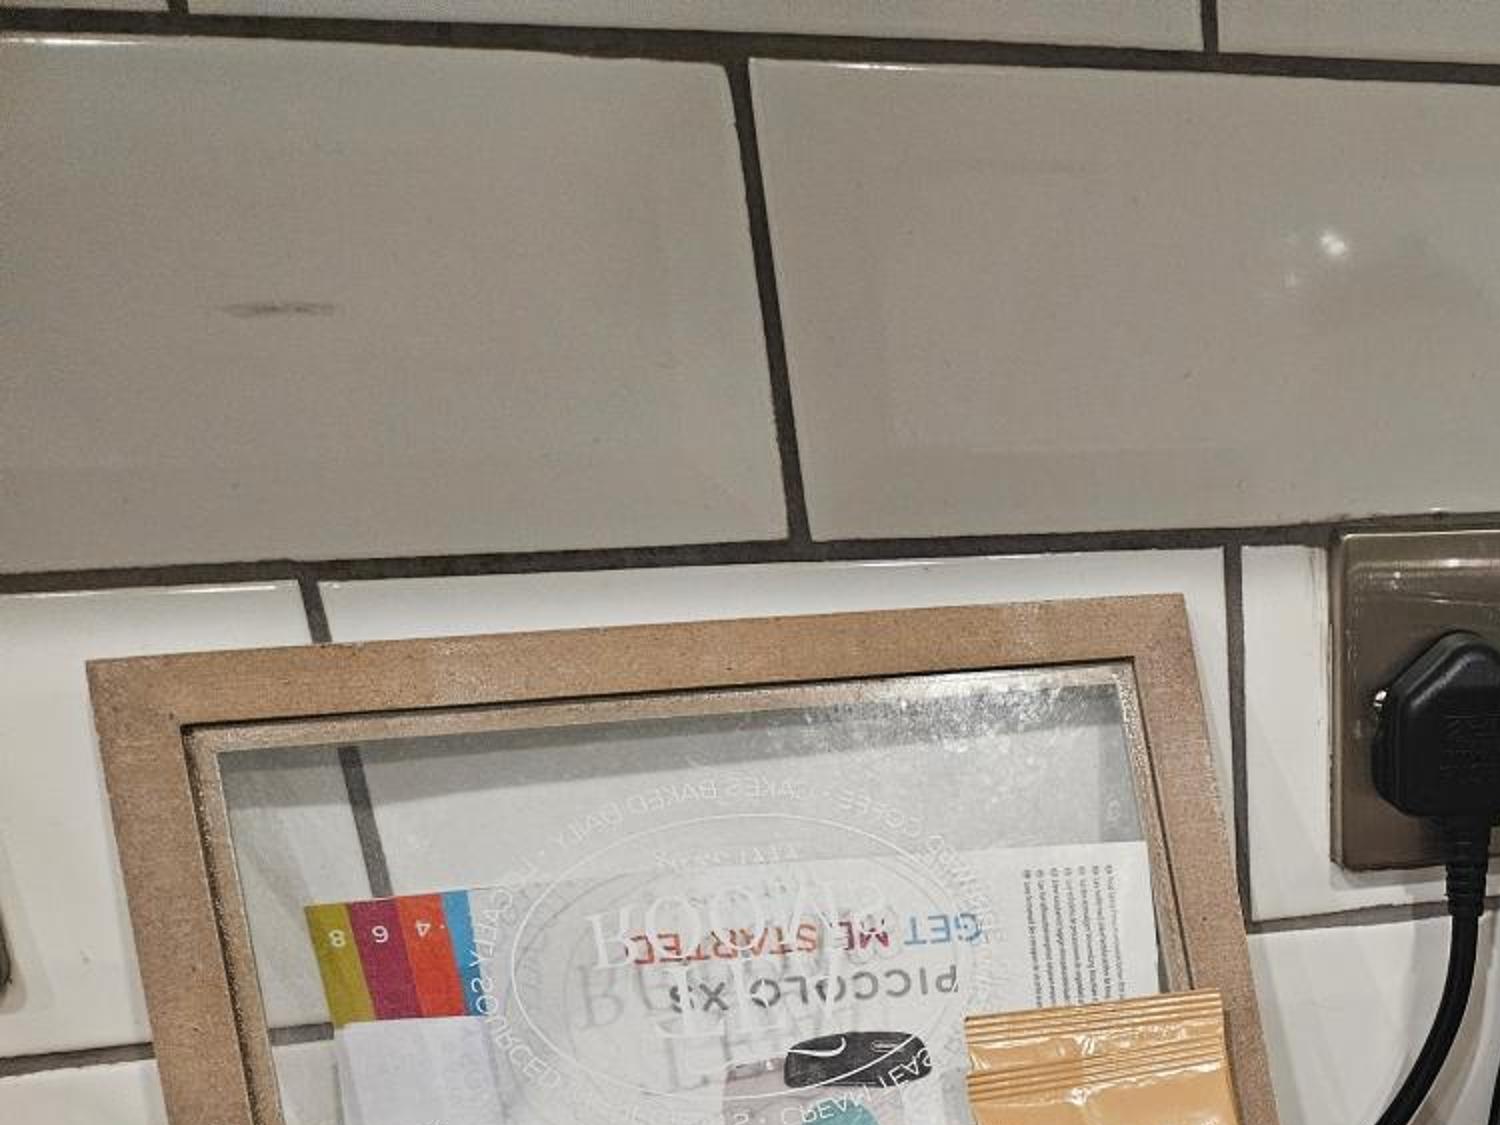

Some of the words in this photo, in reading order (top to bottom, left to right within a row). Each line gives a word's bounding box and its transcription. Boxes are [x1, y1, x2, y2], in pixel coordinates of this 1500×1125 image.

[371, 925, 389, 943] 6
[415, 919, 432, 938] 4
[905, 913, 982, 945] GET
[328, 929, 347, 948] 8
[749, 964, 958, 1009] PICCOLO
